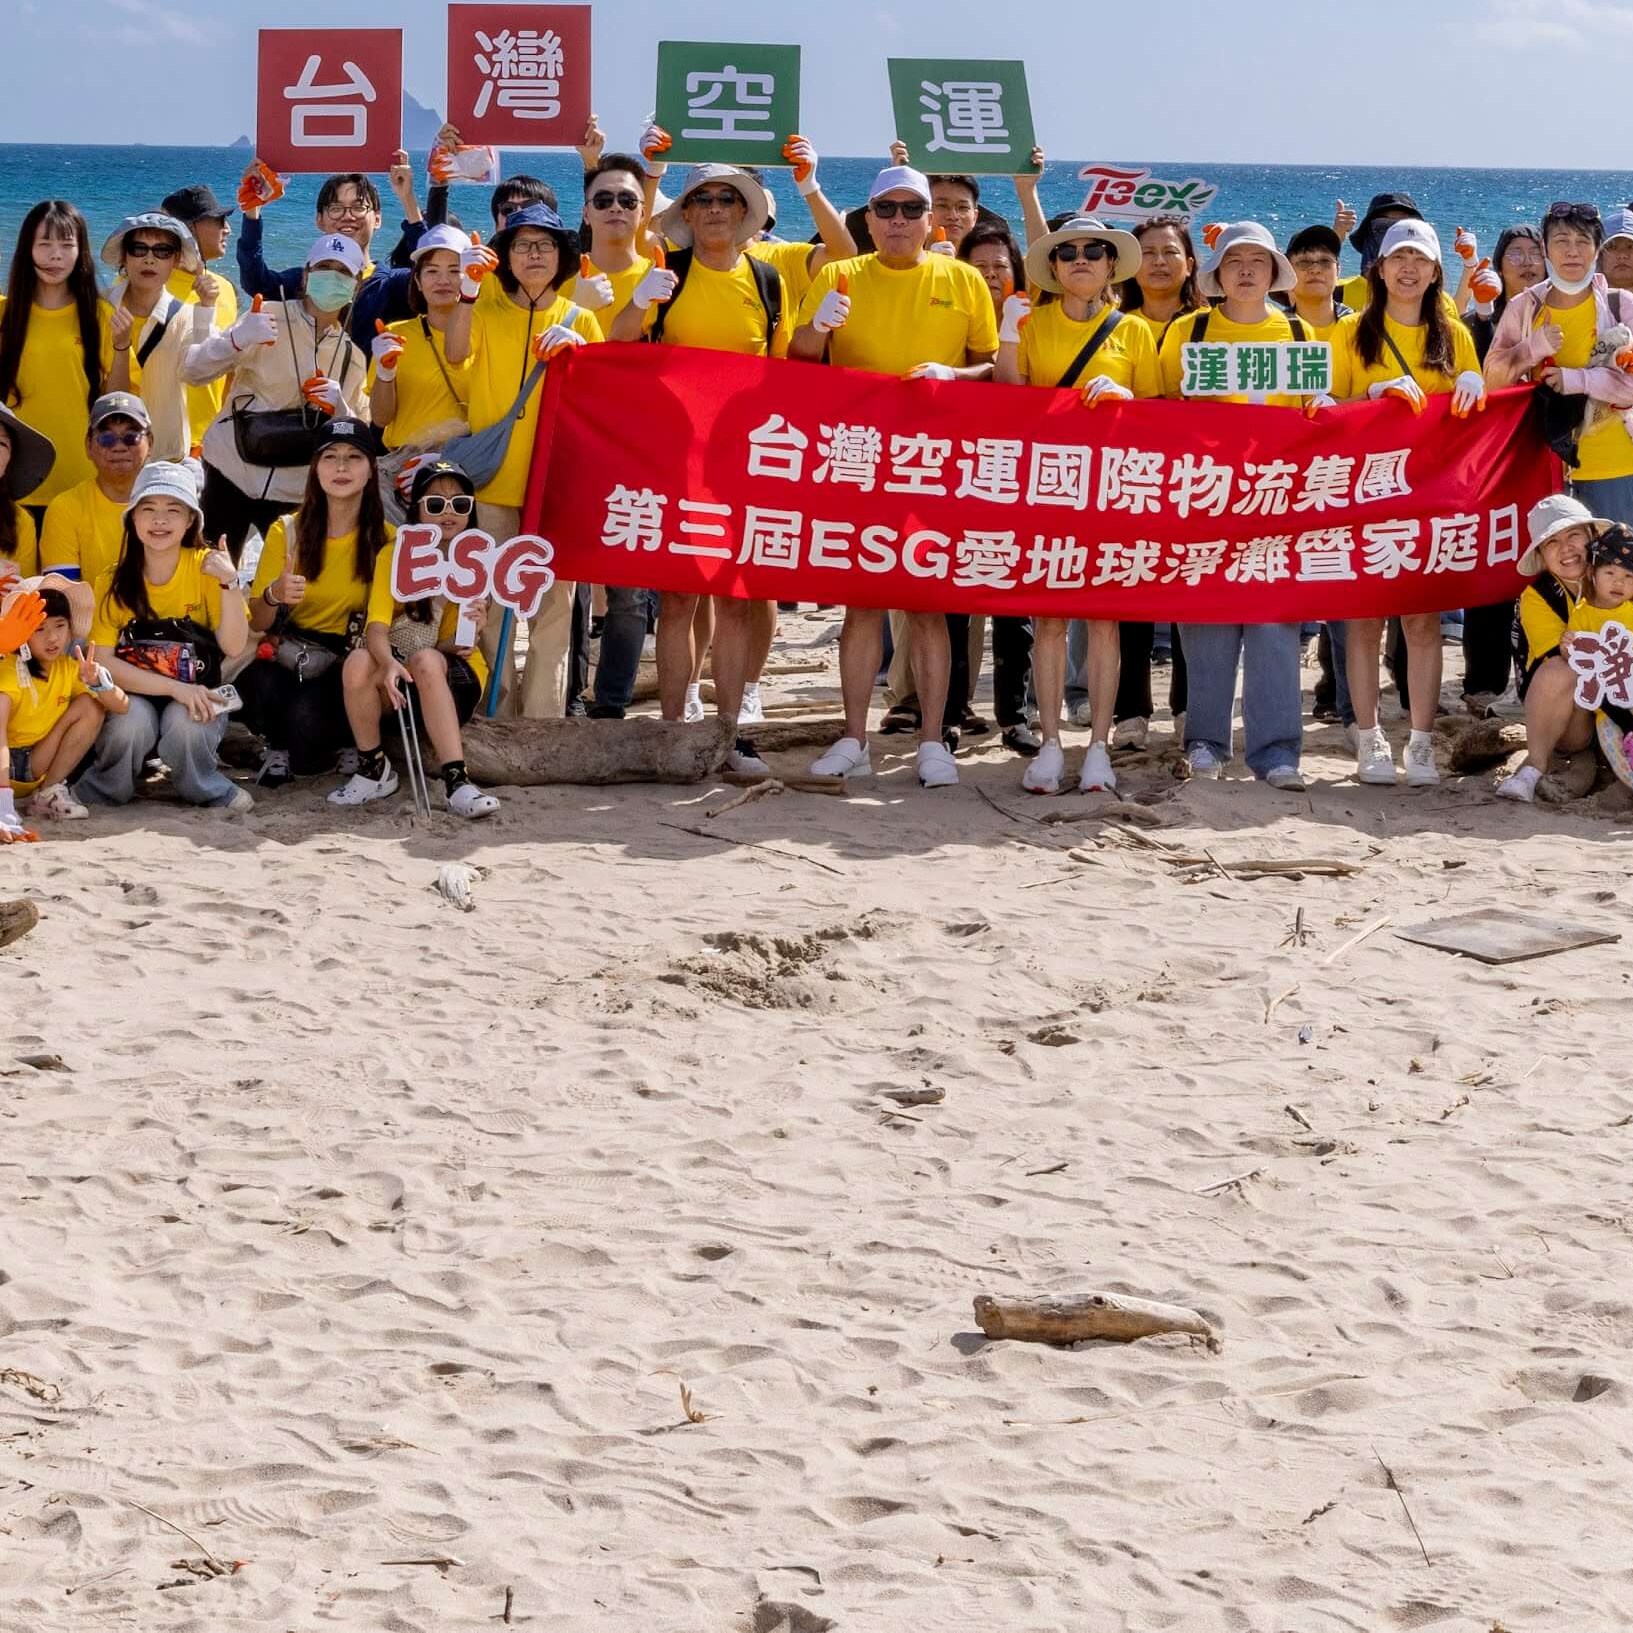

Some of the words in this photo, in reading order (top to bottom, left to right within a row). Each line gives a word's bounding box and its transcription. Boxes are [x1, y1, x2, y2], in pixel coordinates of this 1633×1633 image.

[283, 54, 377, 147] 台
[473, 29, 564, 119] 灣
[681, 65, 775, 141] 空
[919, 80, 1011, 153] 運
[1186, 347, 1328, 391] 漢翔瑞
[747, 414, 1412, 519] 台灣空運國際物流集團
[397, 530, 548, 613] ESG
[600, 483, 1520, 590] 第三屆ESG愛地球淨灘暨家庭日
